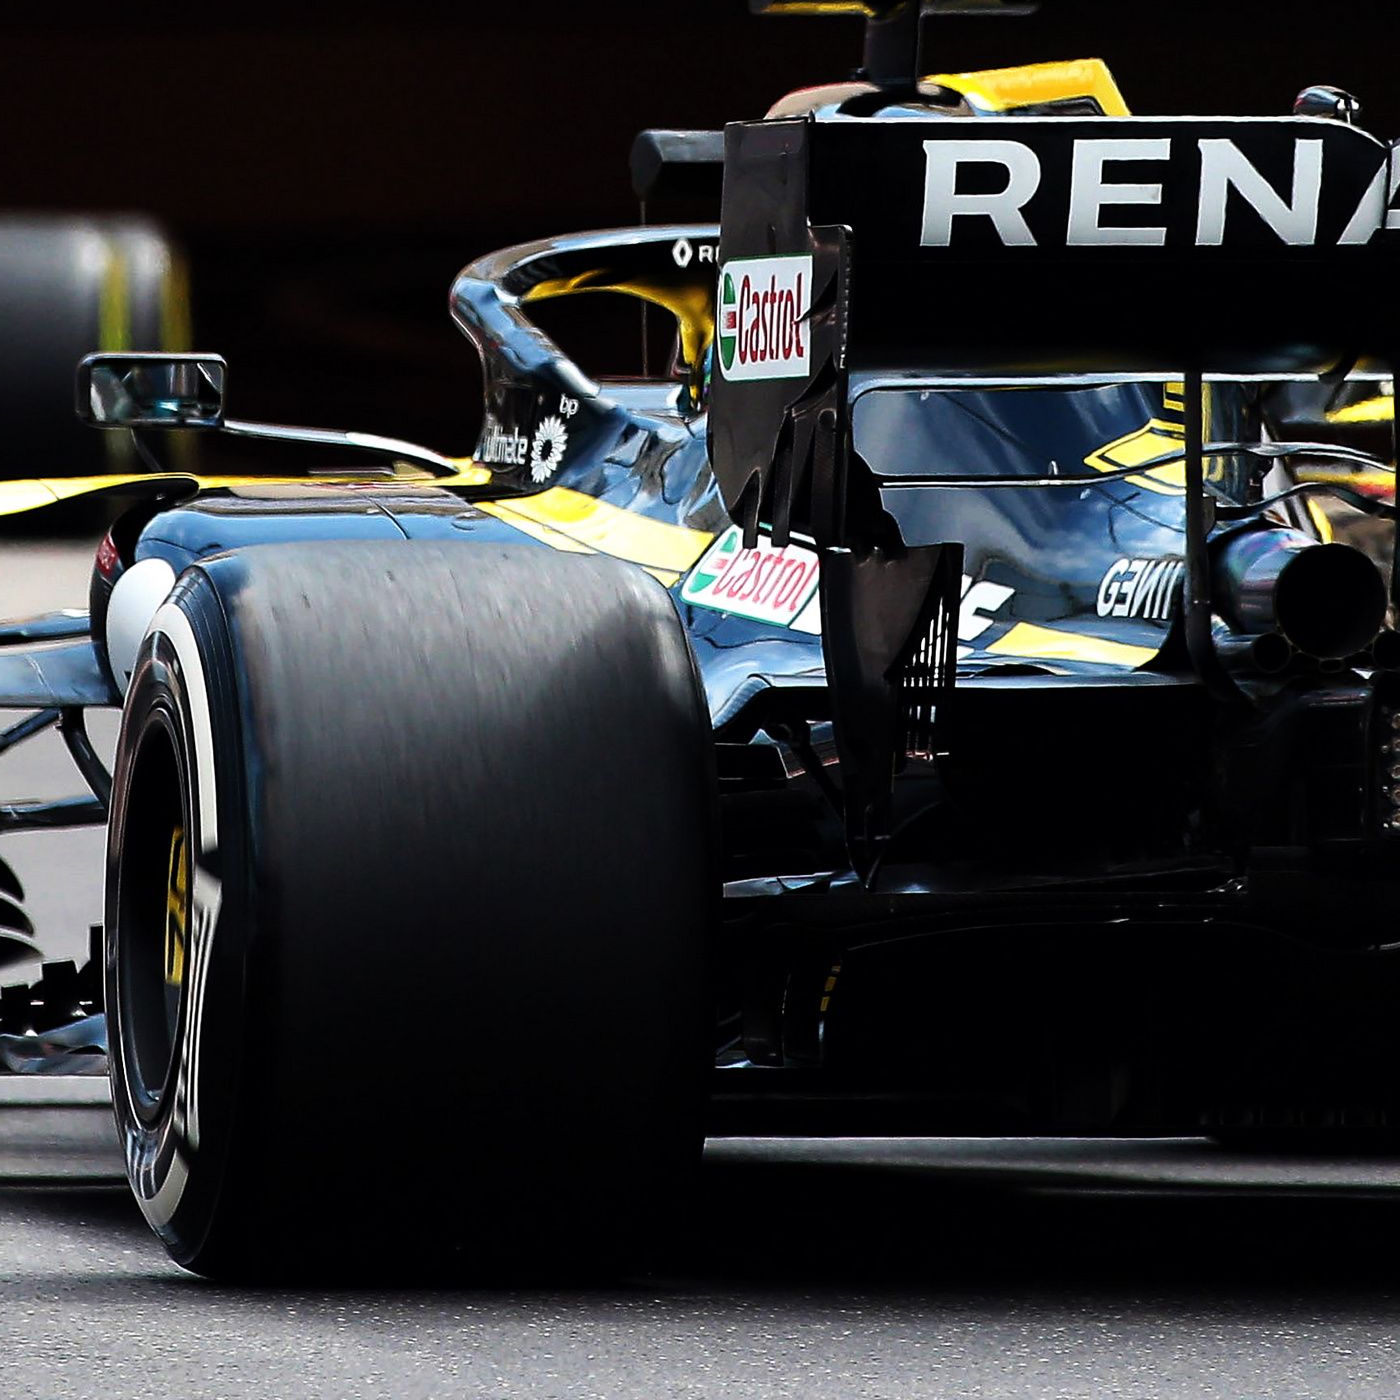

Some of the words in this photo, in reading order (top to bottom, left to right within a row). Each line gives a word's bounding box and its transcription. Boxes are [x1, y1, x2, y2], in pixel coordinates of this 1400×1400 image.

[738, 272, 804, 365] Castrol
[559, 393, 579, 419] bp
[712, 547, 820, 613] Castrol
